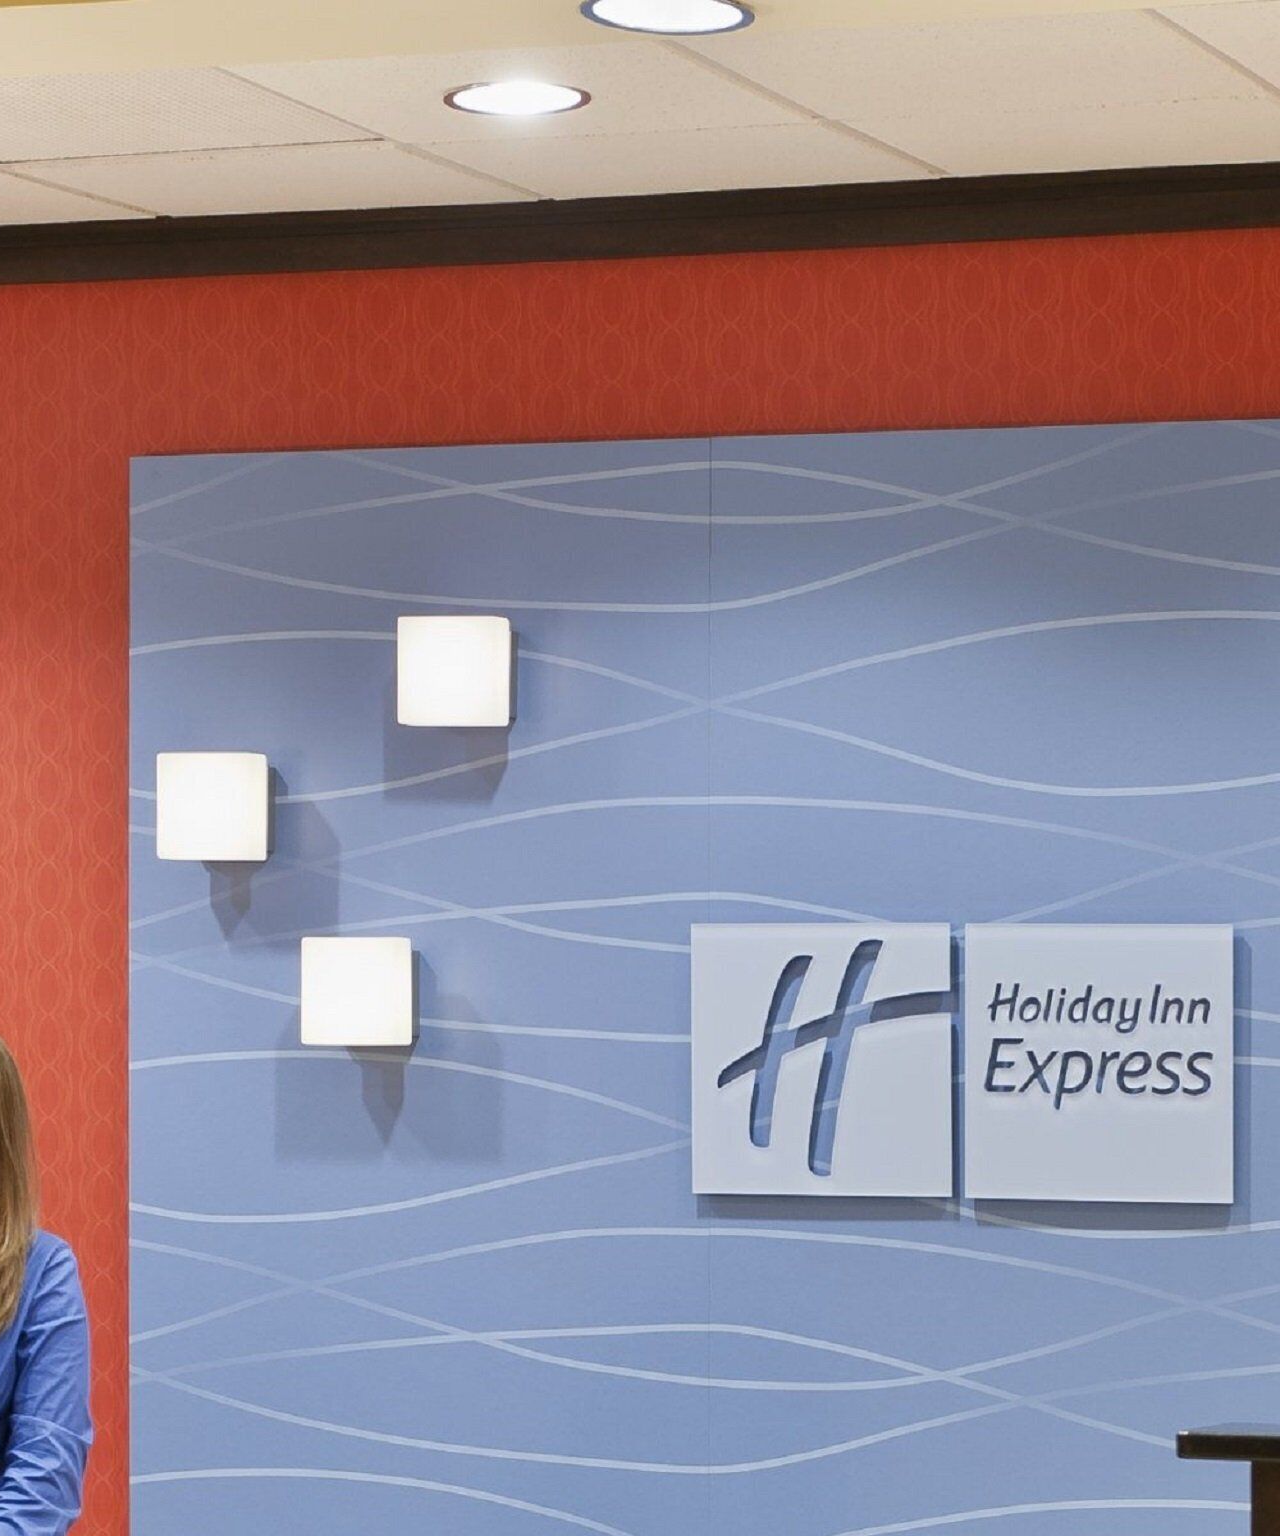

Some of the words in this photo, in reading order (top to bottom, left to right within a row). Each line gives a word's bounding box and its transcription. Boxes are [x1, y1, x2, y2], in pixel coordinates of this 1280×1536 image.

[987, 983, 1143, 1034] Holiday
[1149, 984, 1211, 1024] Inn
[984, 1038, 1214, 1110] Express
